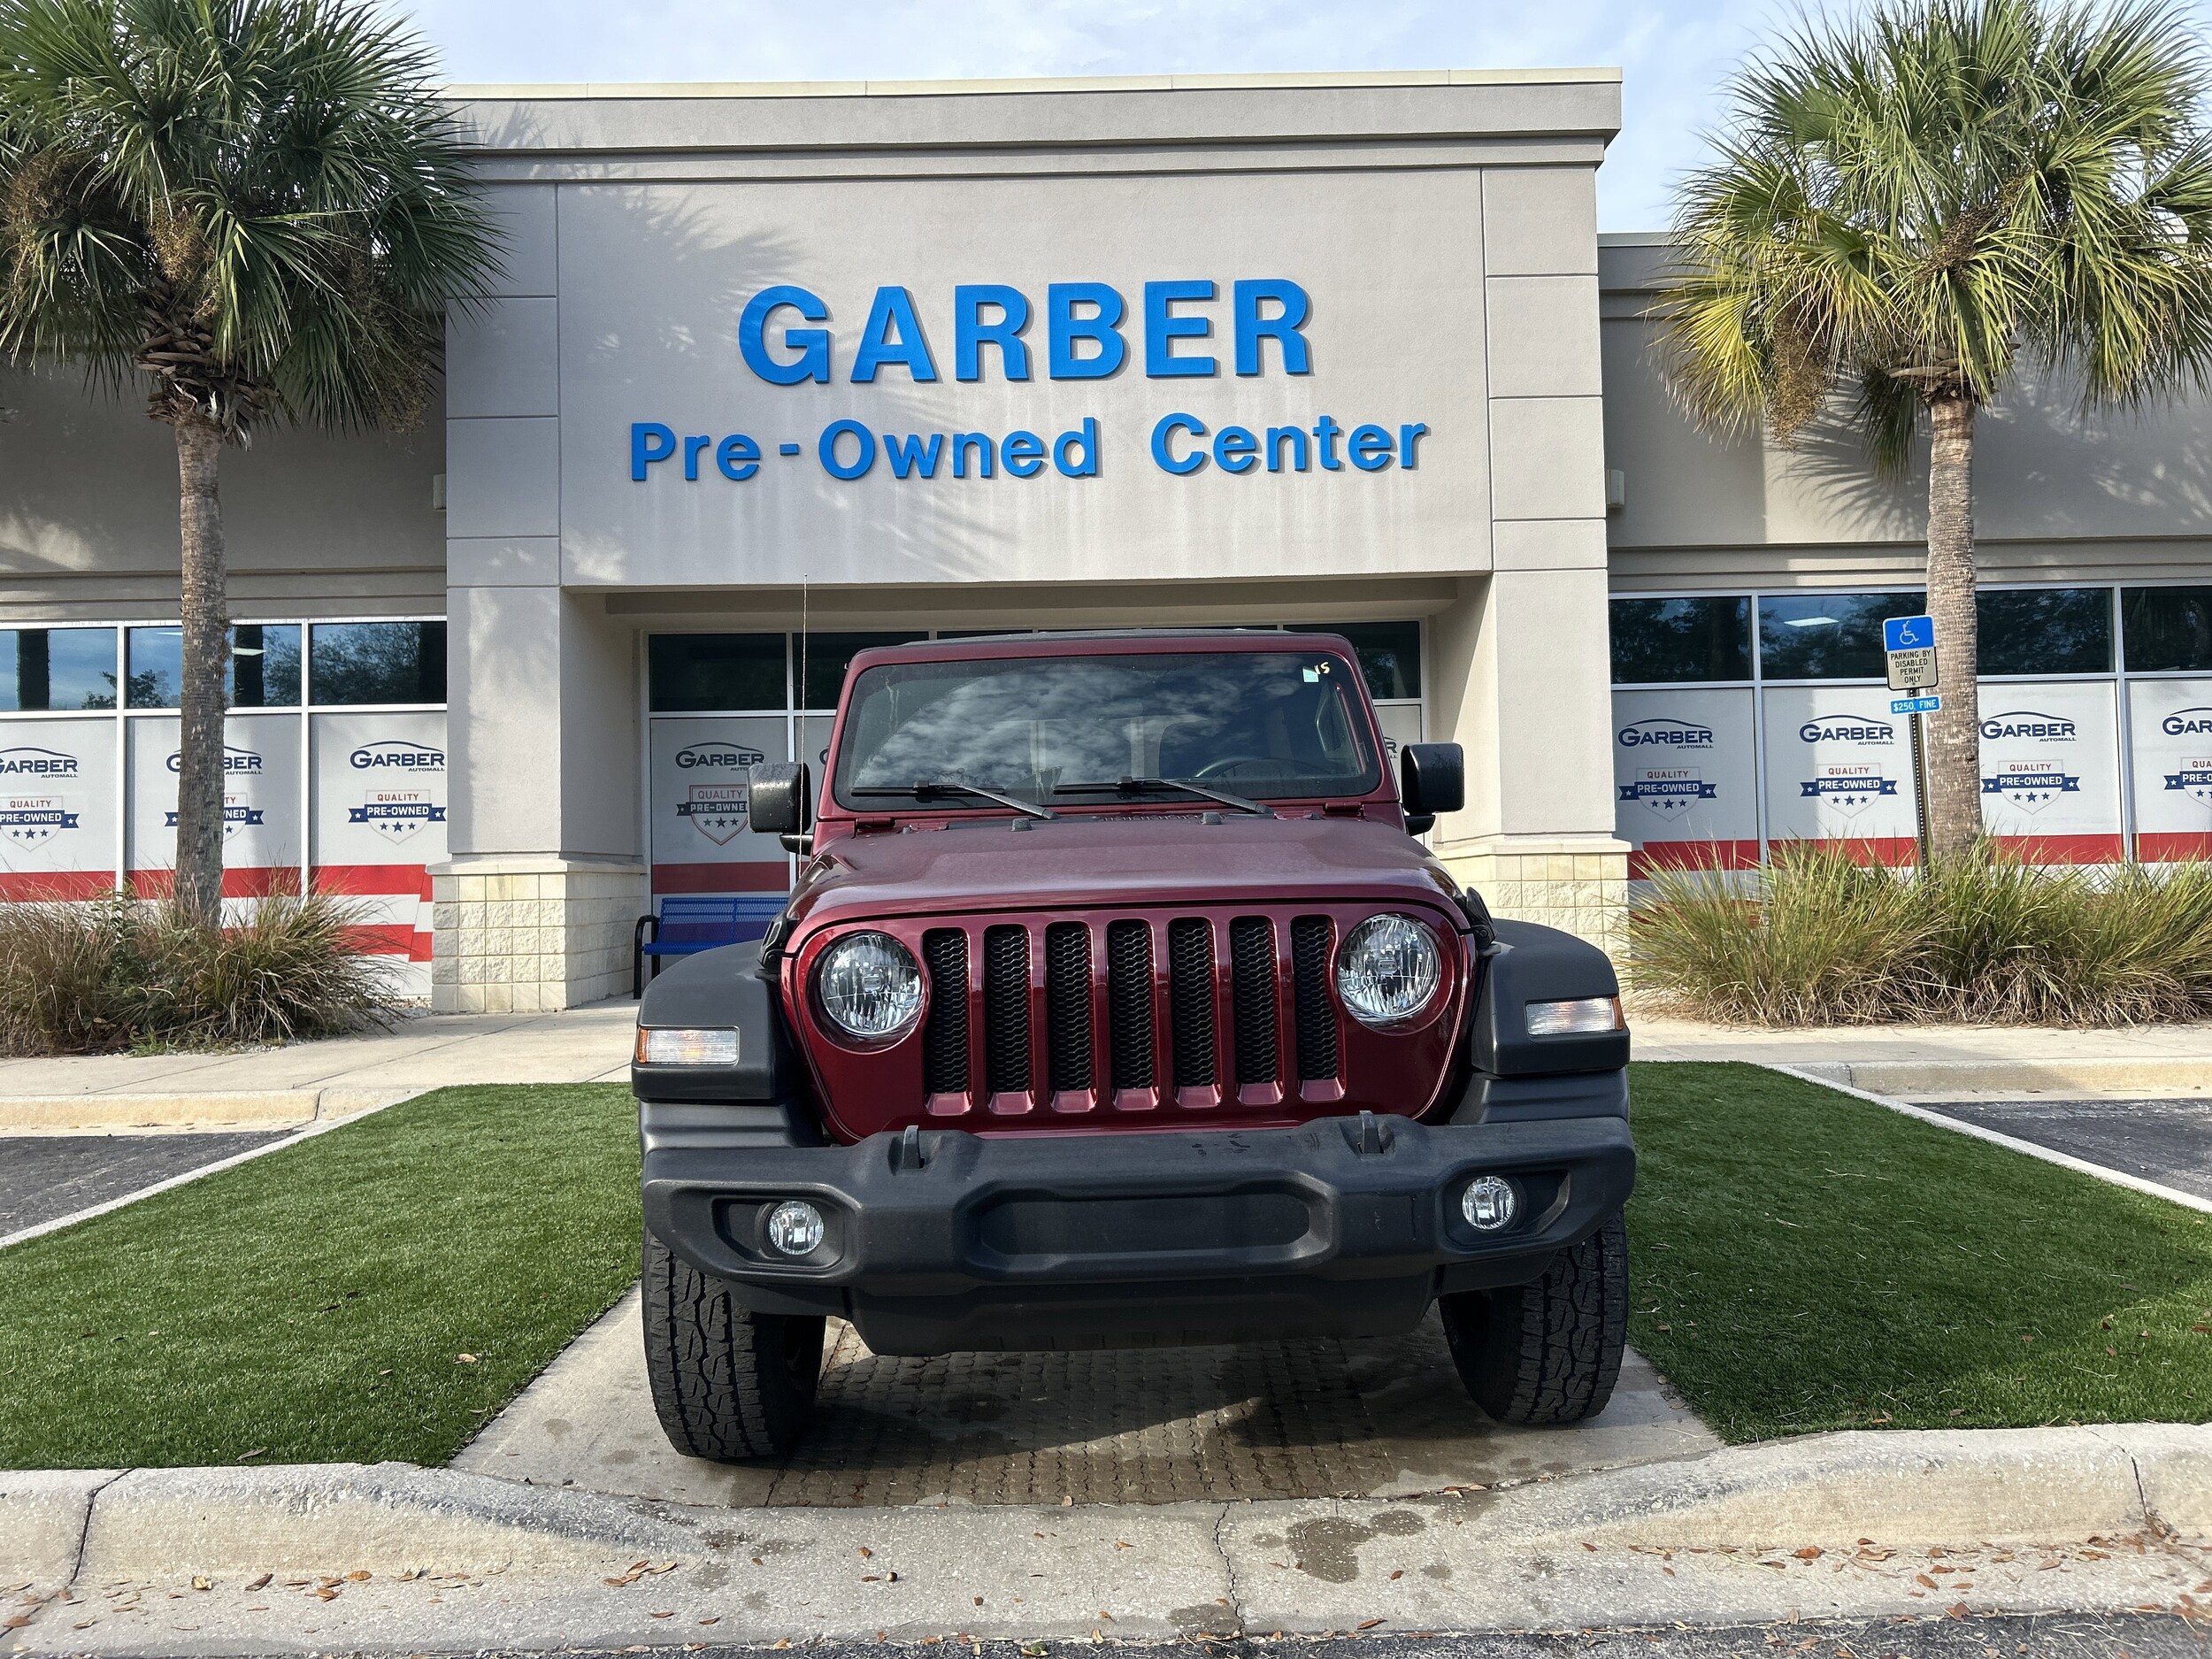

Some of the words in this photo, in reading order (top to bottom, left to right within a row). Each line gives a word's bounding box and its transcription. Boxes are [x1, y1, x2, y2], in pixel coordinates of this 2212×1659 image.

[738, 279, 1312, 384] GARBER
[631, 417, 1099, 481] Pre-Owned
[1150, 412, 1429, 475] Center
[1891, 651, 1919, 660] PARKING
[1895, 658, 1928, 668] DISABLED
[1919, 699, 1937, 709] FINE
[1980, 720, 2077, 740] GARBER
[2162, 717, 2212, 735] GAR
[1618, 727, 1714, 747] GARBER
[1799, 724, 1894, 743] GARBER
[166, 754, 263, 772] GBER
[350, 750, 445, 769] GARBER
[675, 750, 764, 769] GARBER
[1818, 779, 1881, 789] PRE-OWNED
[2000, 777, 2063, 786] PRE-OWNED
[1637, 783, 1701, 793] PRE-OWNED
[697, 790, 743, 800] QUALITY
[10, 800, 51, 809] QUALITY
[690, 803, 748, 811] PRE-OWNE
[366, 806, 429, 816] PRE-OWNED
[0, 812, 62, 823] PRE-OWNED
